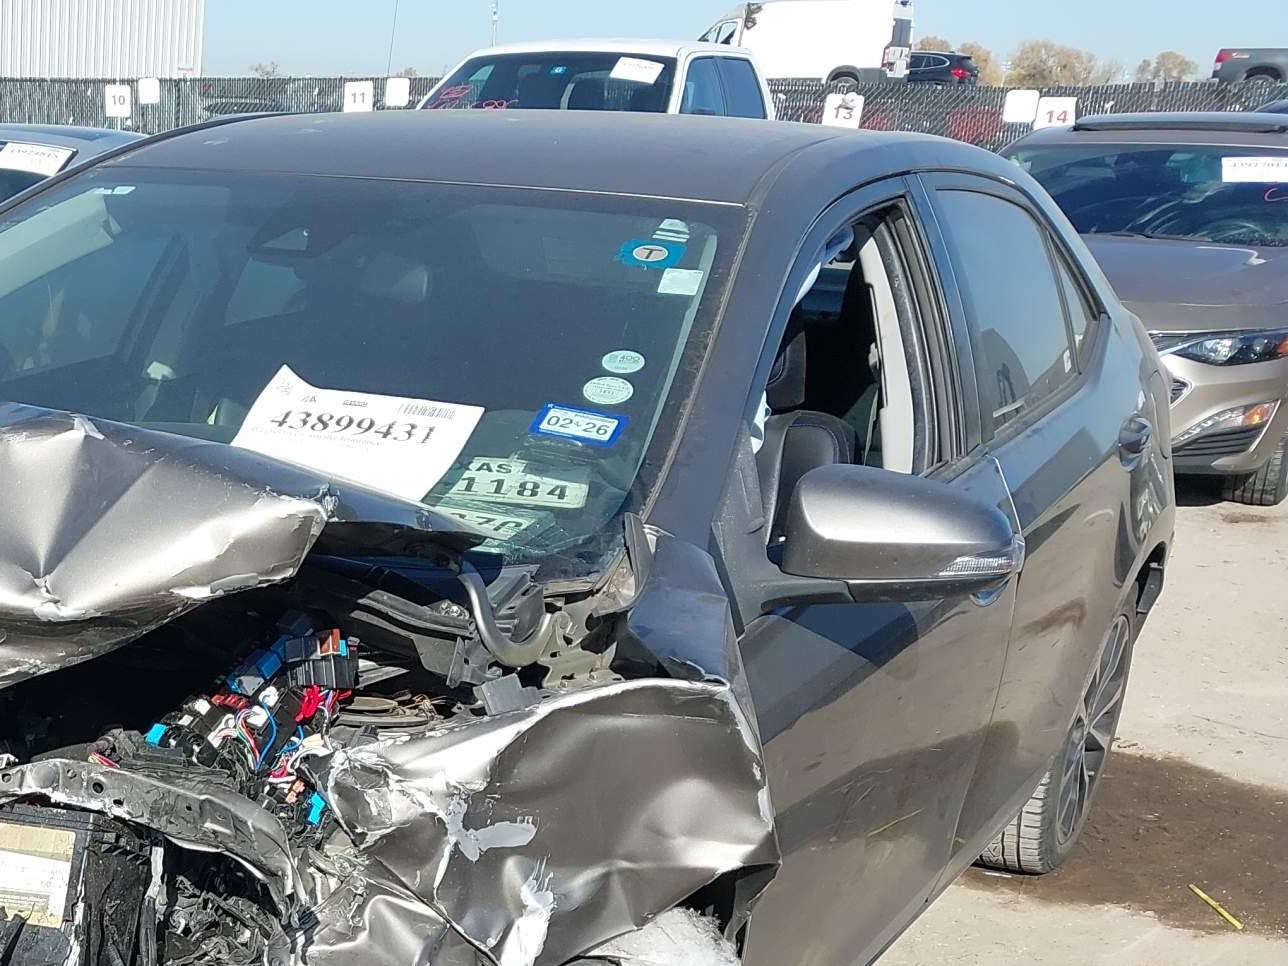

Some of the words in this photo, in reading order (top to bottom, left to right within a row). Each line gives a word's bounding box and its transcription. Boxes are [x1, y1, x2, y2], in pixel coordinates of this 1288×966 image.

[111, 95, 125, 106] 10
[351, 92, 366, 104] 11
[833, 107, 853, 120] 13
[1045, 109, 1069, 123] 14
[642, 247, 663, 260] T
[270, 409, 437, 444] 43899431
[546, 415, 574, 429] 02
[582, 422, 611, 436] 26
[456, 476, 569, 501] 1184
